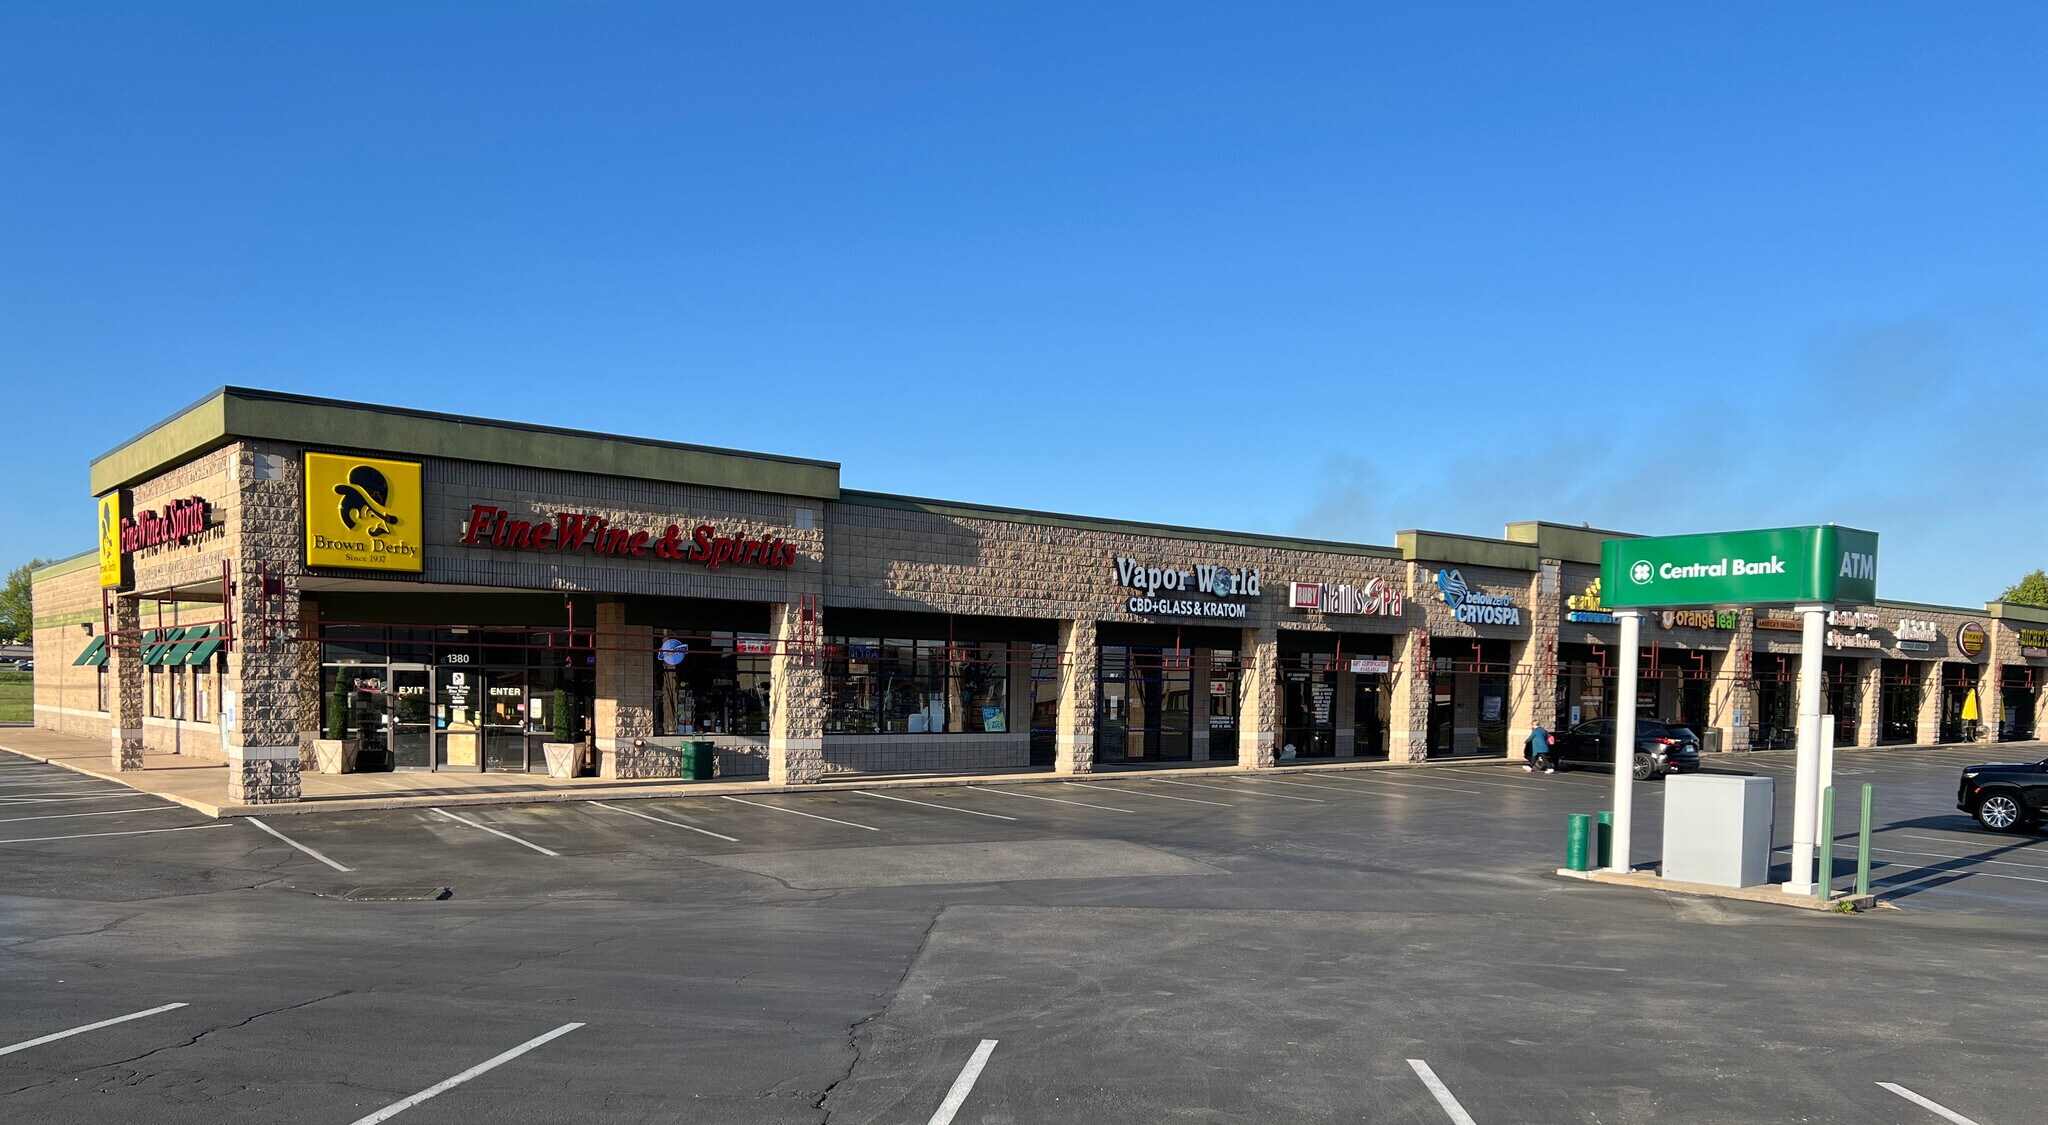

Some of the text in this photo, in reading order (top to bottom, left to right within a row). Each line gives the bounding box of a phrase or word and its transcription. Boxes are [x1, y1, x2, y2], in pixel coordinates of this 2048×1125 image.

[121, 495, 204, 554] Fine Wine & Spirits
[312, 533, 418, 558] Brown Derby
[462, 504, 798, 569] Fine Wine & Spirits
[345, 553, 387, 563] Since 1937
[1659, 555, 1786, 580] Central Bank
[1839, 551, 1875, 580] ATM
[1117, 557, 1190, 597] Vapor
[1297, 576, 1402, 617] RUBY Nails Spa
[1203, 601, 1246, 618] KRATOM
[1457, 603, 1520, 626] CRYOSPA
[1676, 609, 1738, 630] orange leaf
[2020, 628, 2048, 648] DICKEY
[447, 654, 470, 663] 1380
[399, 686, 425, 695] EXIT
[490, 687, 521, 696] ENTER
